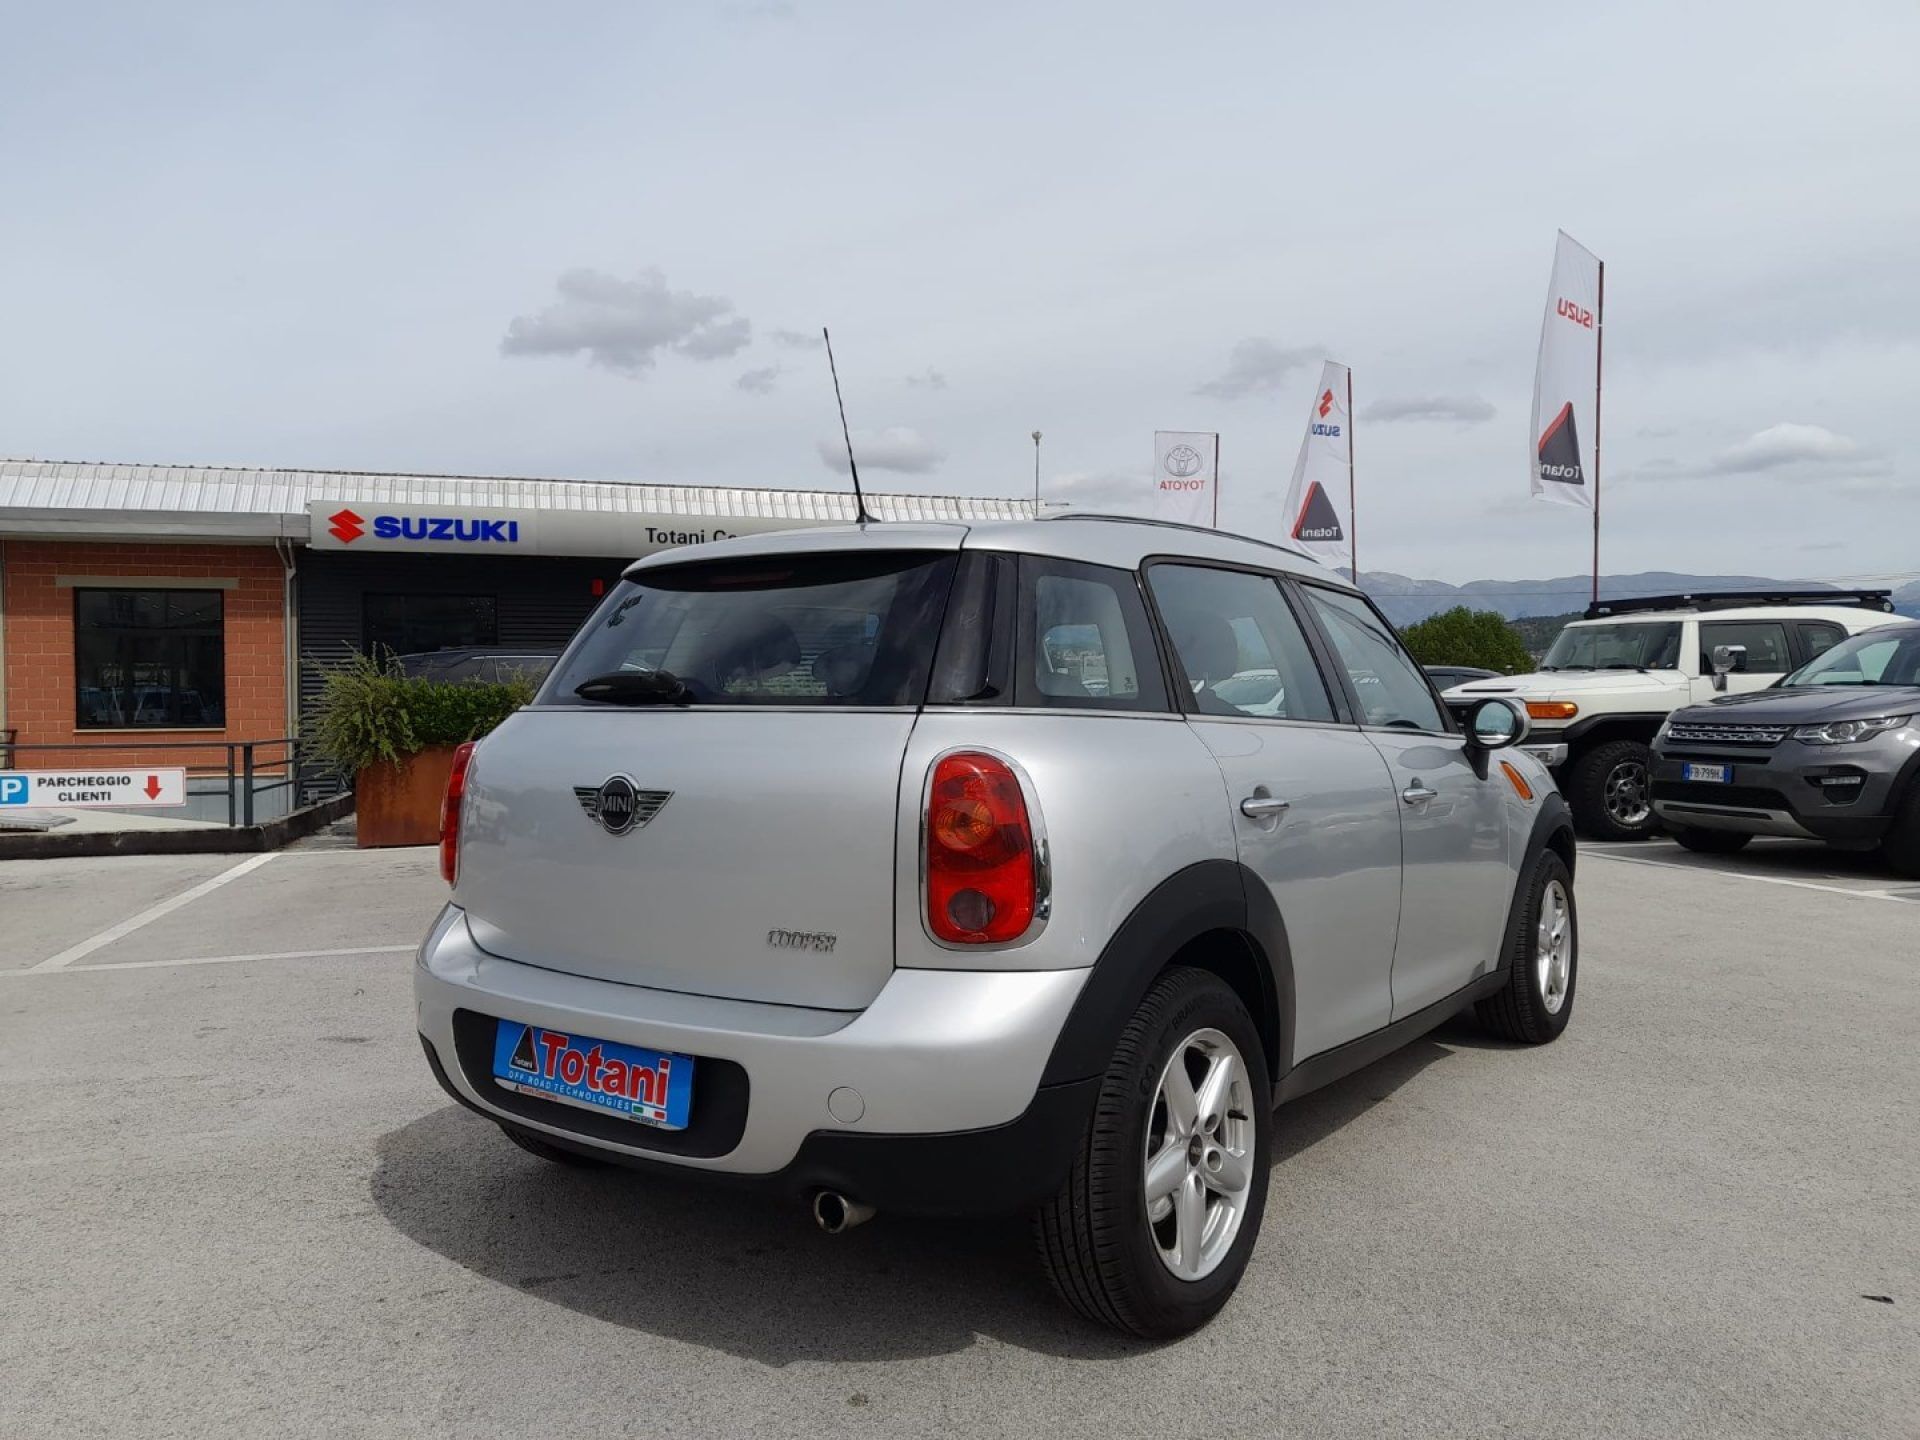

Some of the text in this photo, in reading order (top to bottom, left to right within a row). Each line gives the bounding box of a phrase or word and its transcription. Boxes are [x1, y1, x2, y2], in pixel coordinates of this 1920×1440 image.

[373, 515, 519, 543] SUZUKI
[645, 527, 705, 545] Totani
[1, 778, 22, 802] P
[37, 775, 132, 788] PARCHEGGIO
[58, 791, 112, 802] CLIENTI
[601, 795, 634, 813] MINI
[541, 1031, 670, 1107] Totani
[508, 1070, 524, 1082] OFF
[528, 1077, 552, 1090] ROAD
[554, 1083, 629, 1111] TECHNOLOGIES
